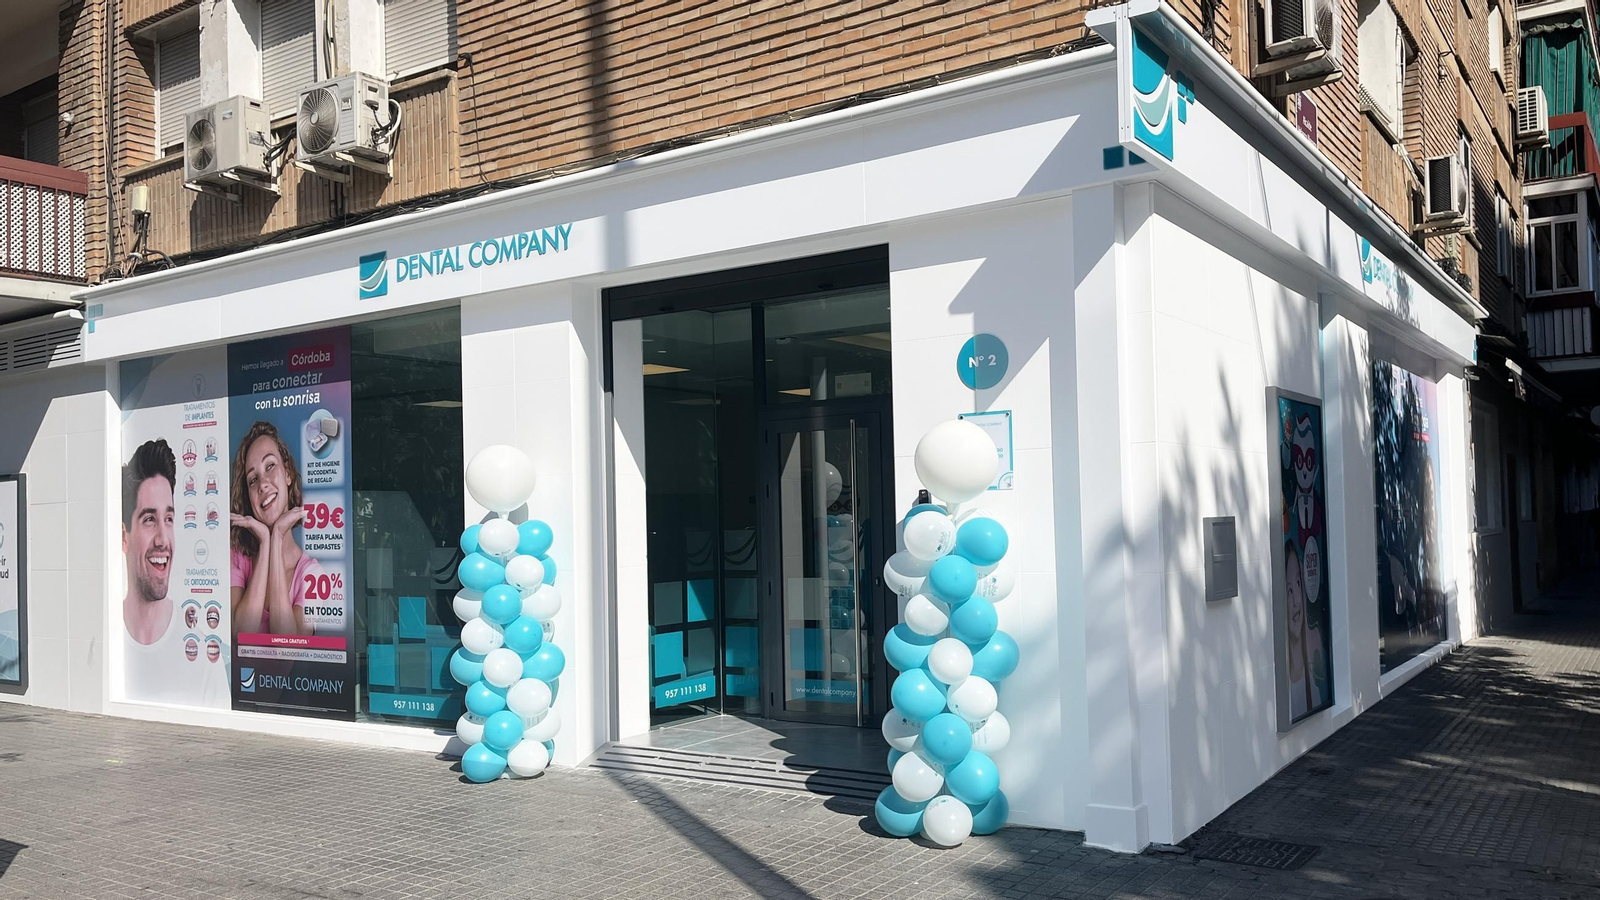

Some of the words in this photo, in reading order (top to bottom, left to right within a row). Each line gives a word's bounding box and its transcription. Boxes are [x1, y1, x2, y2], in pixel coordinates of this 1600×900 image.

[396, 246, 464, 282] DENTAL
[468, 223, 572, 268] COMPANY
[260, 360, 279, 370] llegado
[291, 350, 330, 366] Córdoba
[988, 354, 996, 366] 2
[252, 382, 270, 394] para
[272, 371, 322, 389] conectar
[255, 400, 270, 410] con
[273, 398, 280, 408] tu
[282, 390, 320, 406] sonrisa
[192, 411, 214, 420] IMPLANTES
[303, 503, 344, 529] 39€
[304, 606, 314, 615] EN
[316, 607, 343, 616] TODOS
[259, 675, 292, 690] DENTAL
[294, 677, 344, 694] COMPANY
[665, 688, 678, 698] 957
[681, 686, 692, 696] 111
[695, 683, 706, 692] 138
[393, 700, 406, 709] 957
[408, 702, 420, 710] 111
[422, 703, 434, 711] 138
